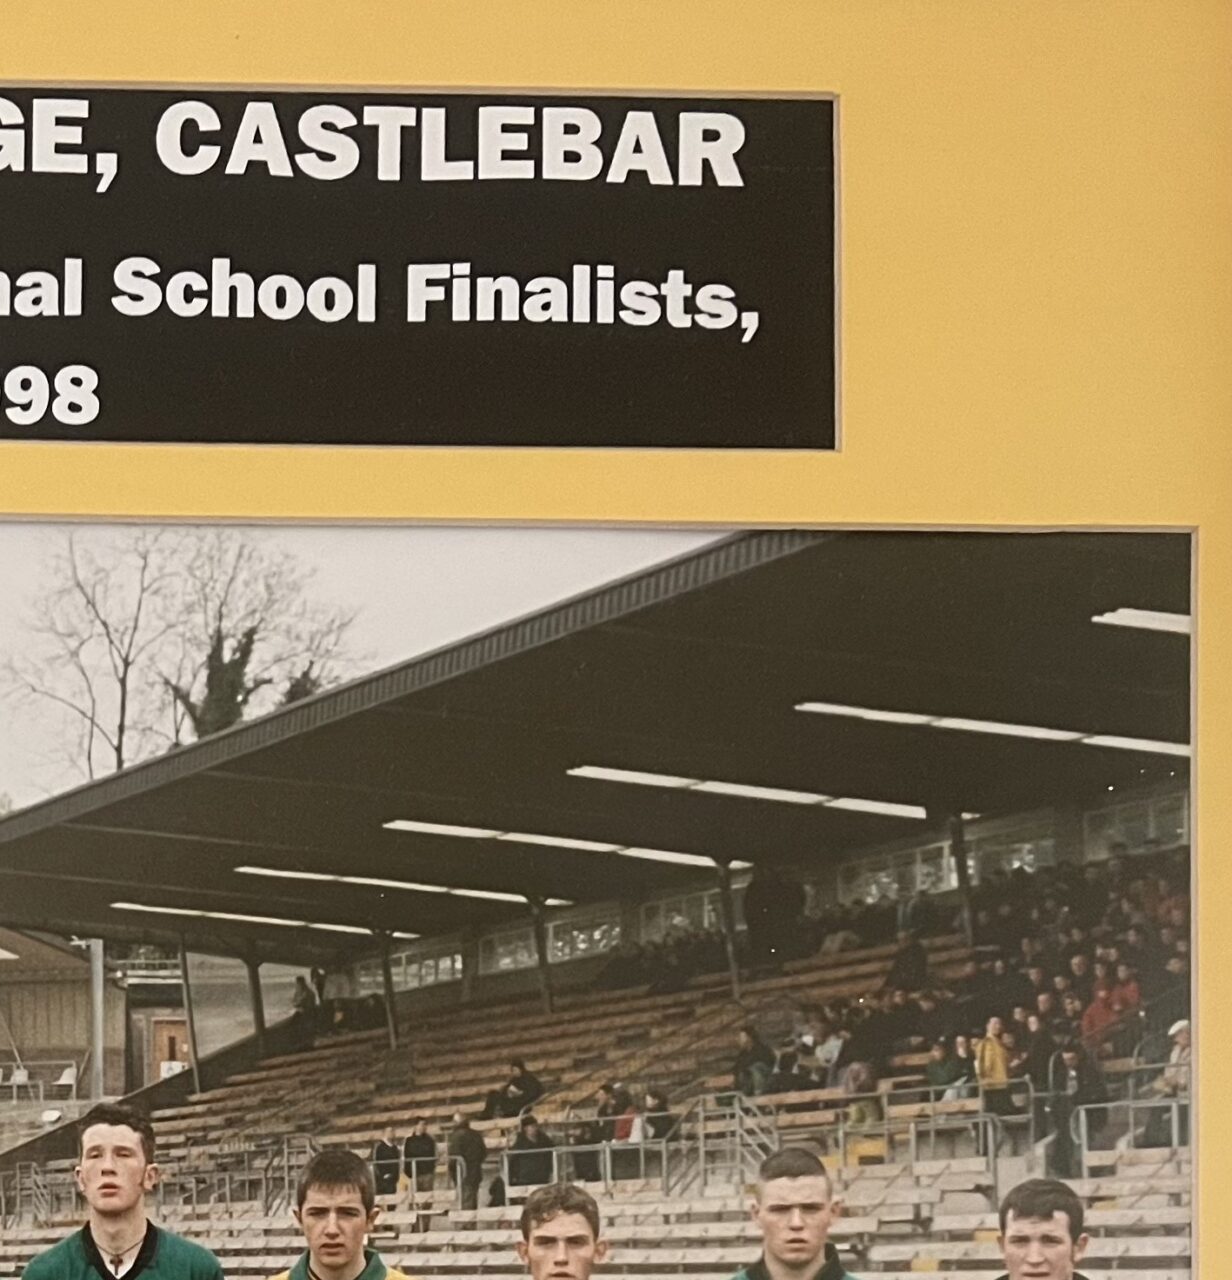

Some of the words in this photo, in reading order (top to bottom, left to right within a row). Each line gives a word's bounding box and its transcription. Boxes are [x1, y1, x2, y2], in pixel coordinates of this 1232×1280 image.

[155, 100, 746, 187] CASTLEBAR
[111, 257, 376, 323] School
[407, 262, 759, 343] Finalists,
